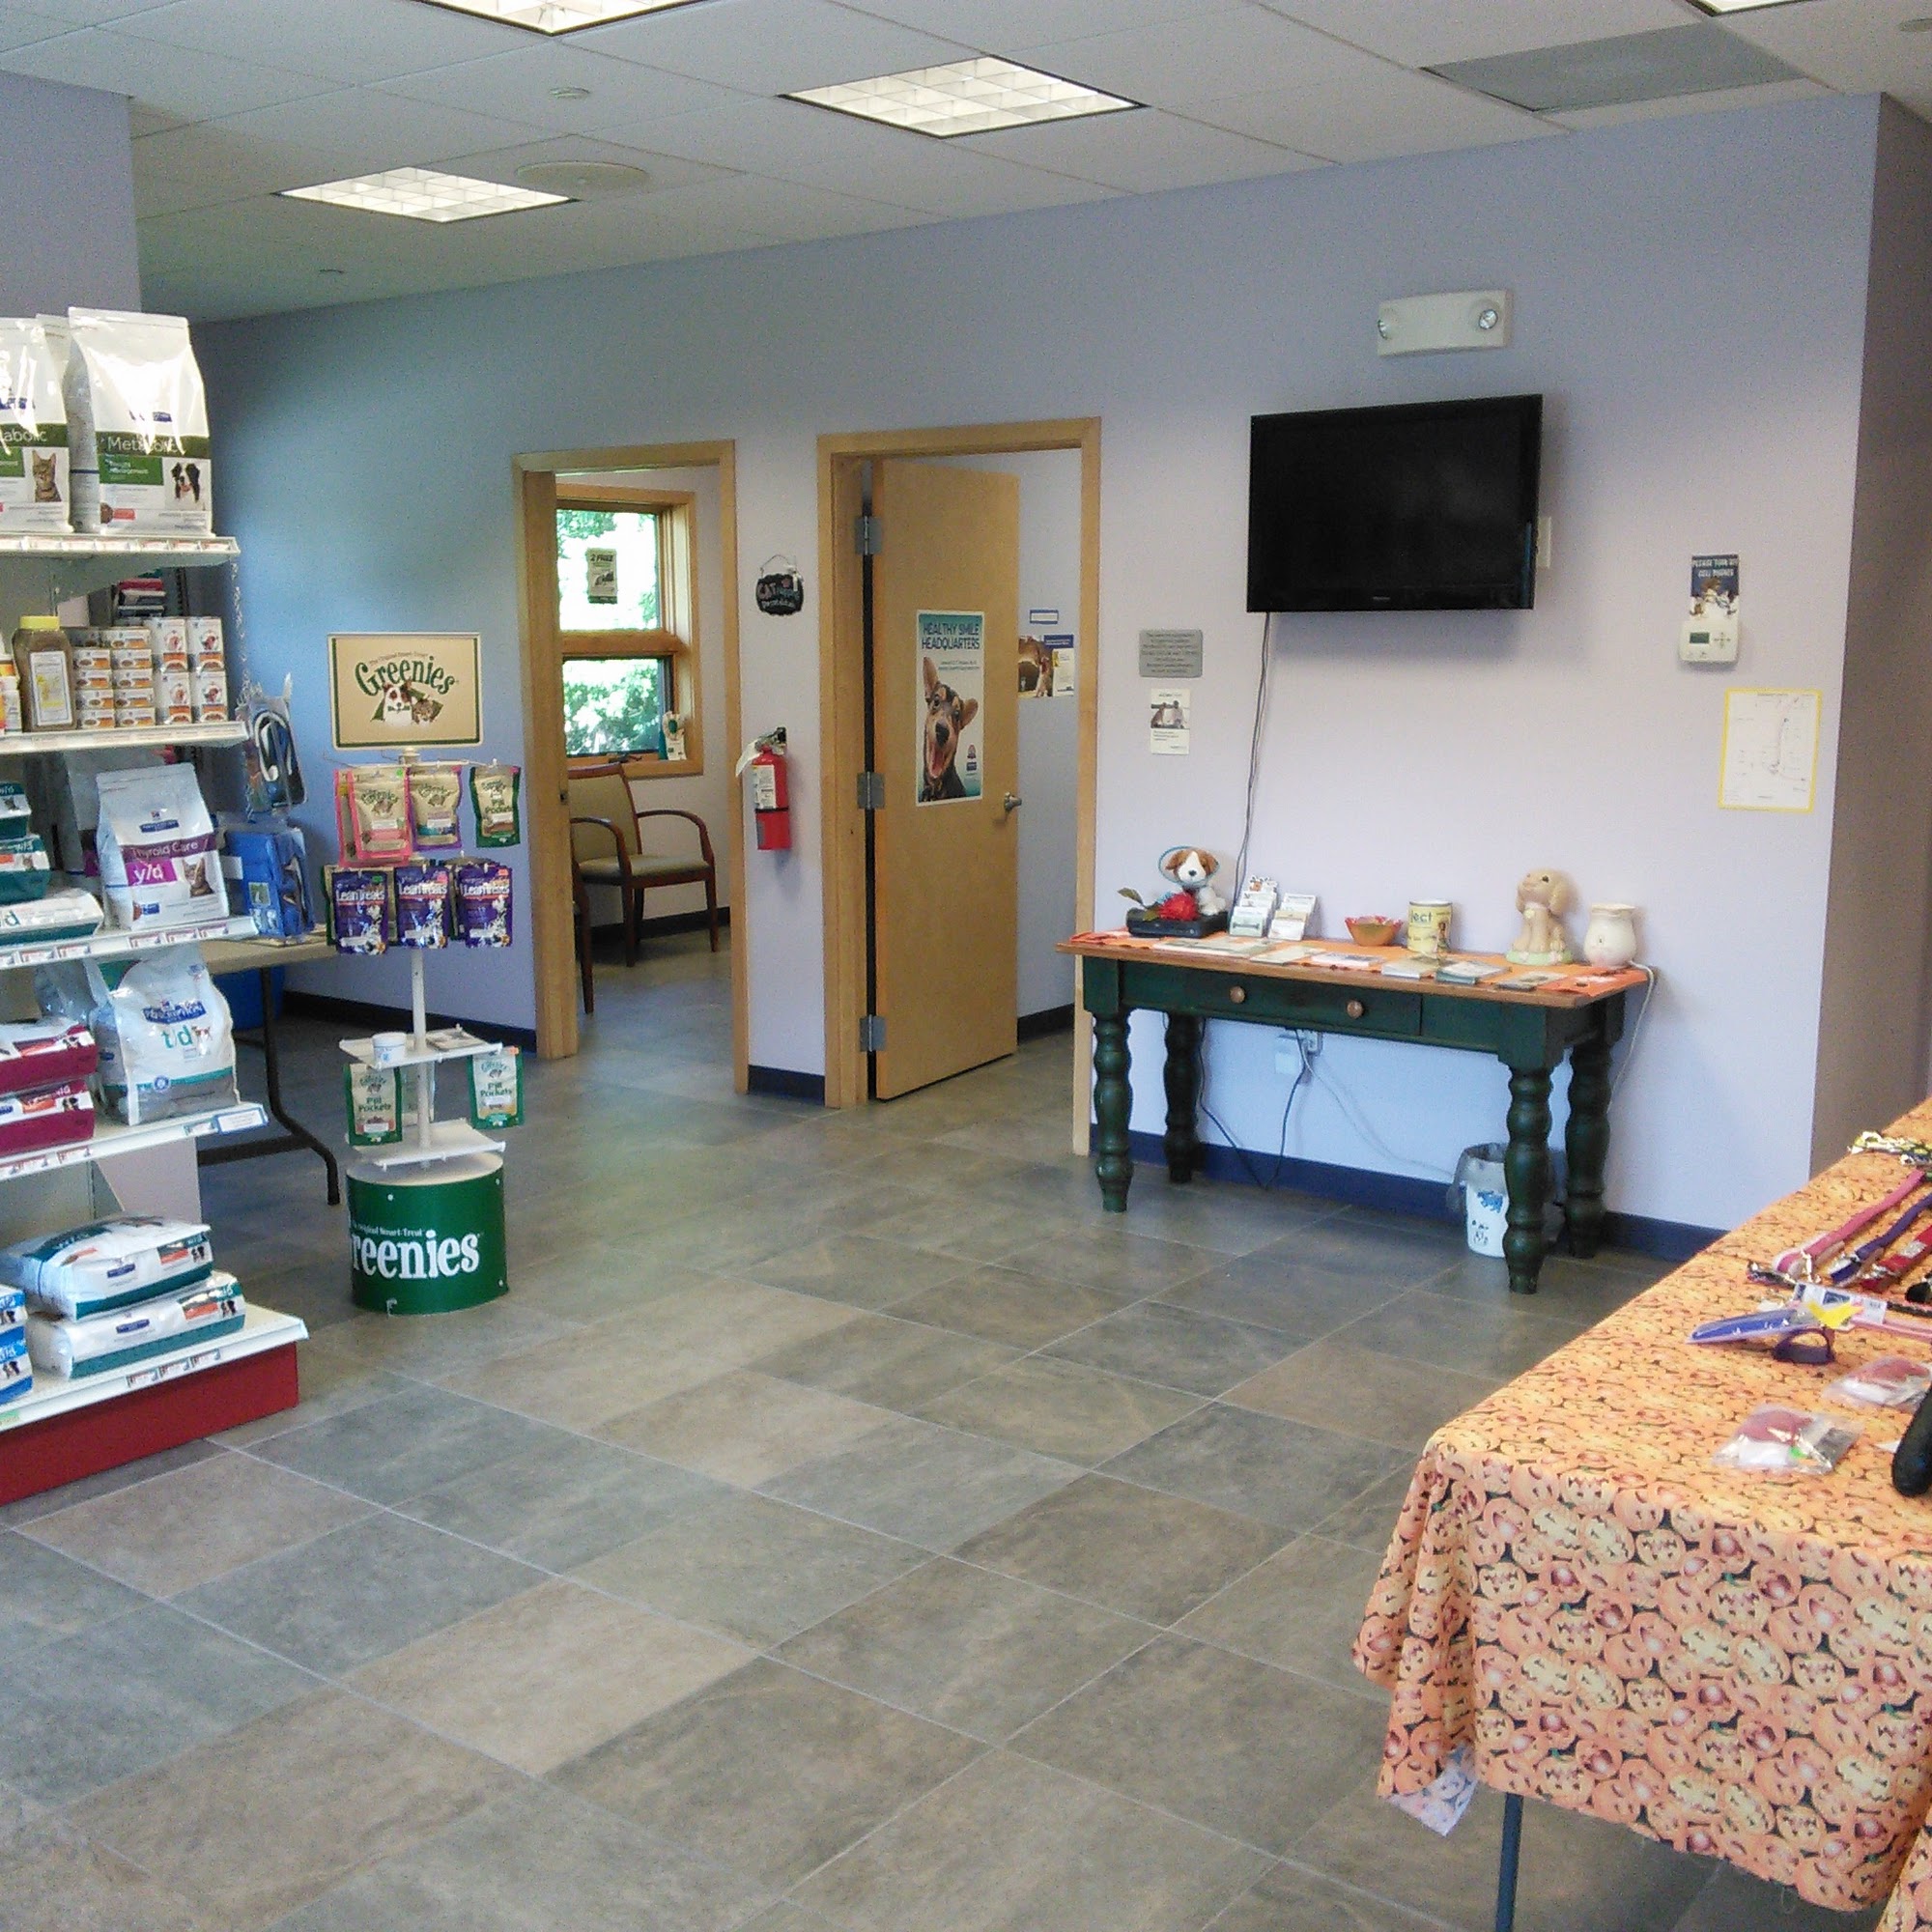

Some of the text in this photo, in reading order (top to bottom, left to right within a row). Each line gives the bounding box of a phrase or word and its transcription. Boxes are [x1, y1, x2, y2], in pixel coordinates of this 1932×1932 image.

[923, 623, 980, 636] HEALTHY SMILE
[922, 637, 980, 650] HEADQUARTERS
[355, 655, 456, 696] Greenies
[172, 840, 199, 853] Care
[133, 864, 164, 886] y/d
[335, 888, 385, 902] LeanTreats
[161, 1025, 193, 1049] t/d
[480, 1088, 513, 1097] Pockets
[358, 1103, 392, 1113] Pockets
